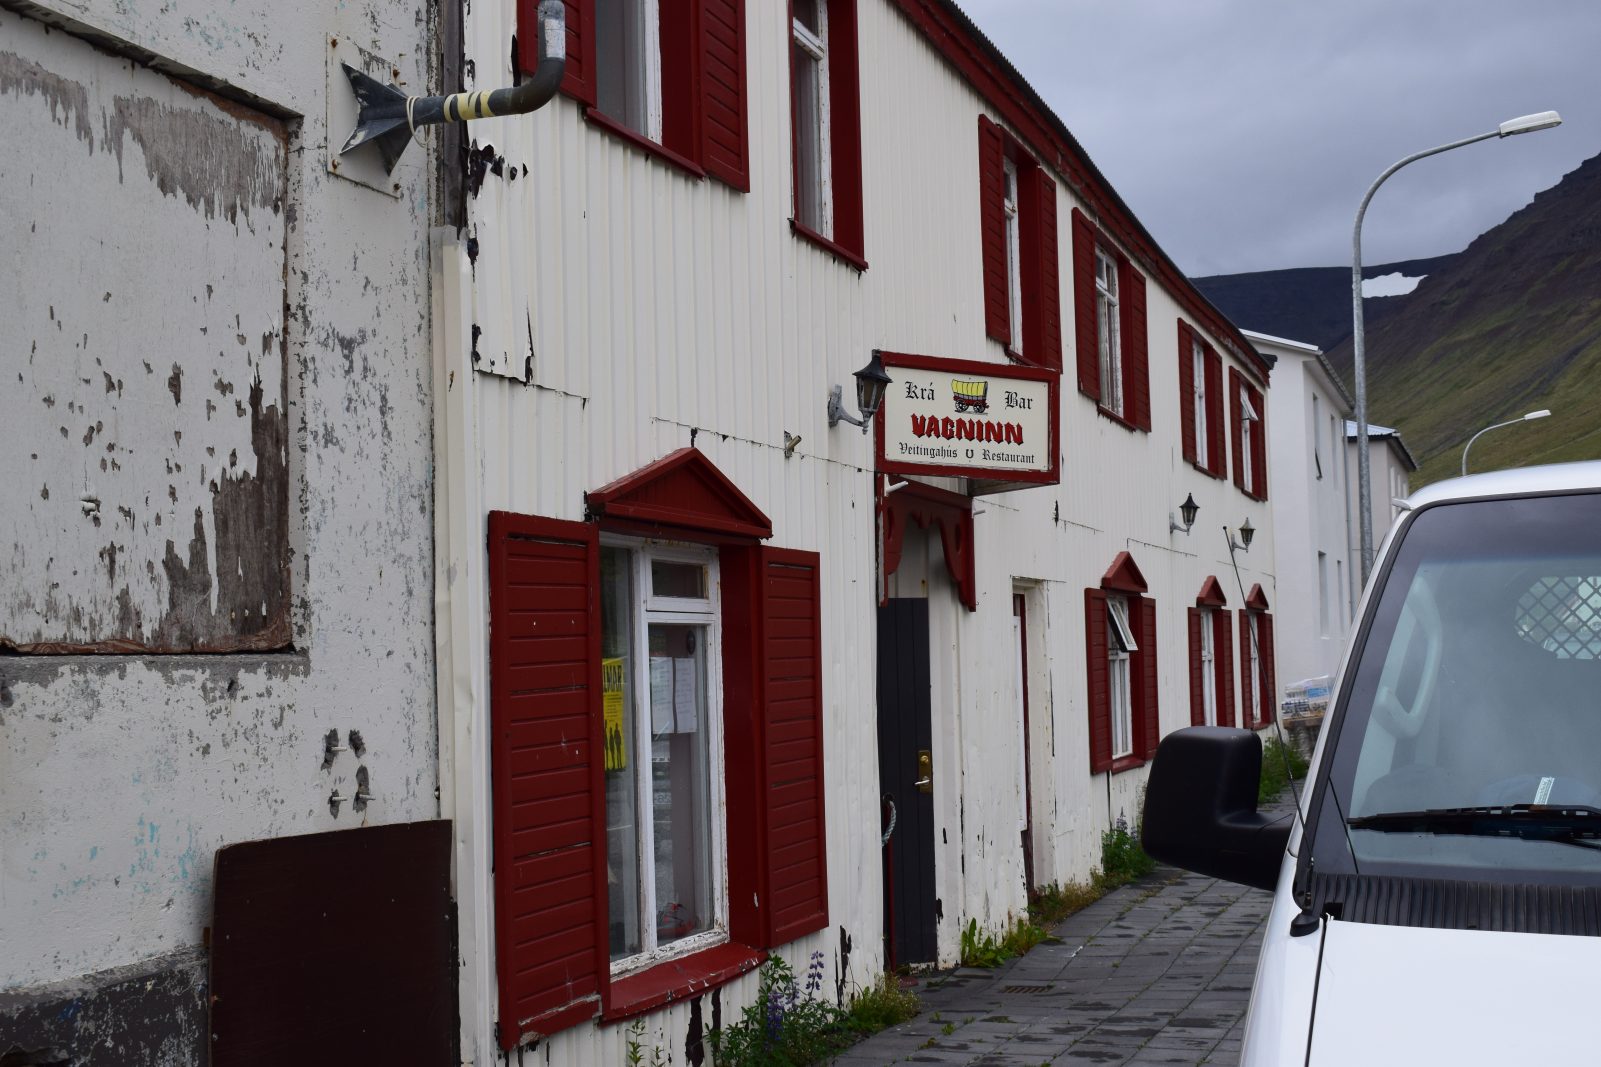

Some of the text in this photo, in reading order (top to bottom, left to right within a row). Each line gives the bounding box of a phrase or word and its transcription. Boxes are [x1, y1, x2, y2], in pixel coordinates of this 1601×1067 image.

[904, 381, 935, 401] Krá
[1004, 390, 1034, 410] Bar
[910, 412, 1024, 446] VAGNINN
[898, 442, 1035, 464] Veitingahús Restaurant
